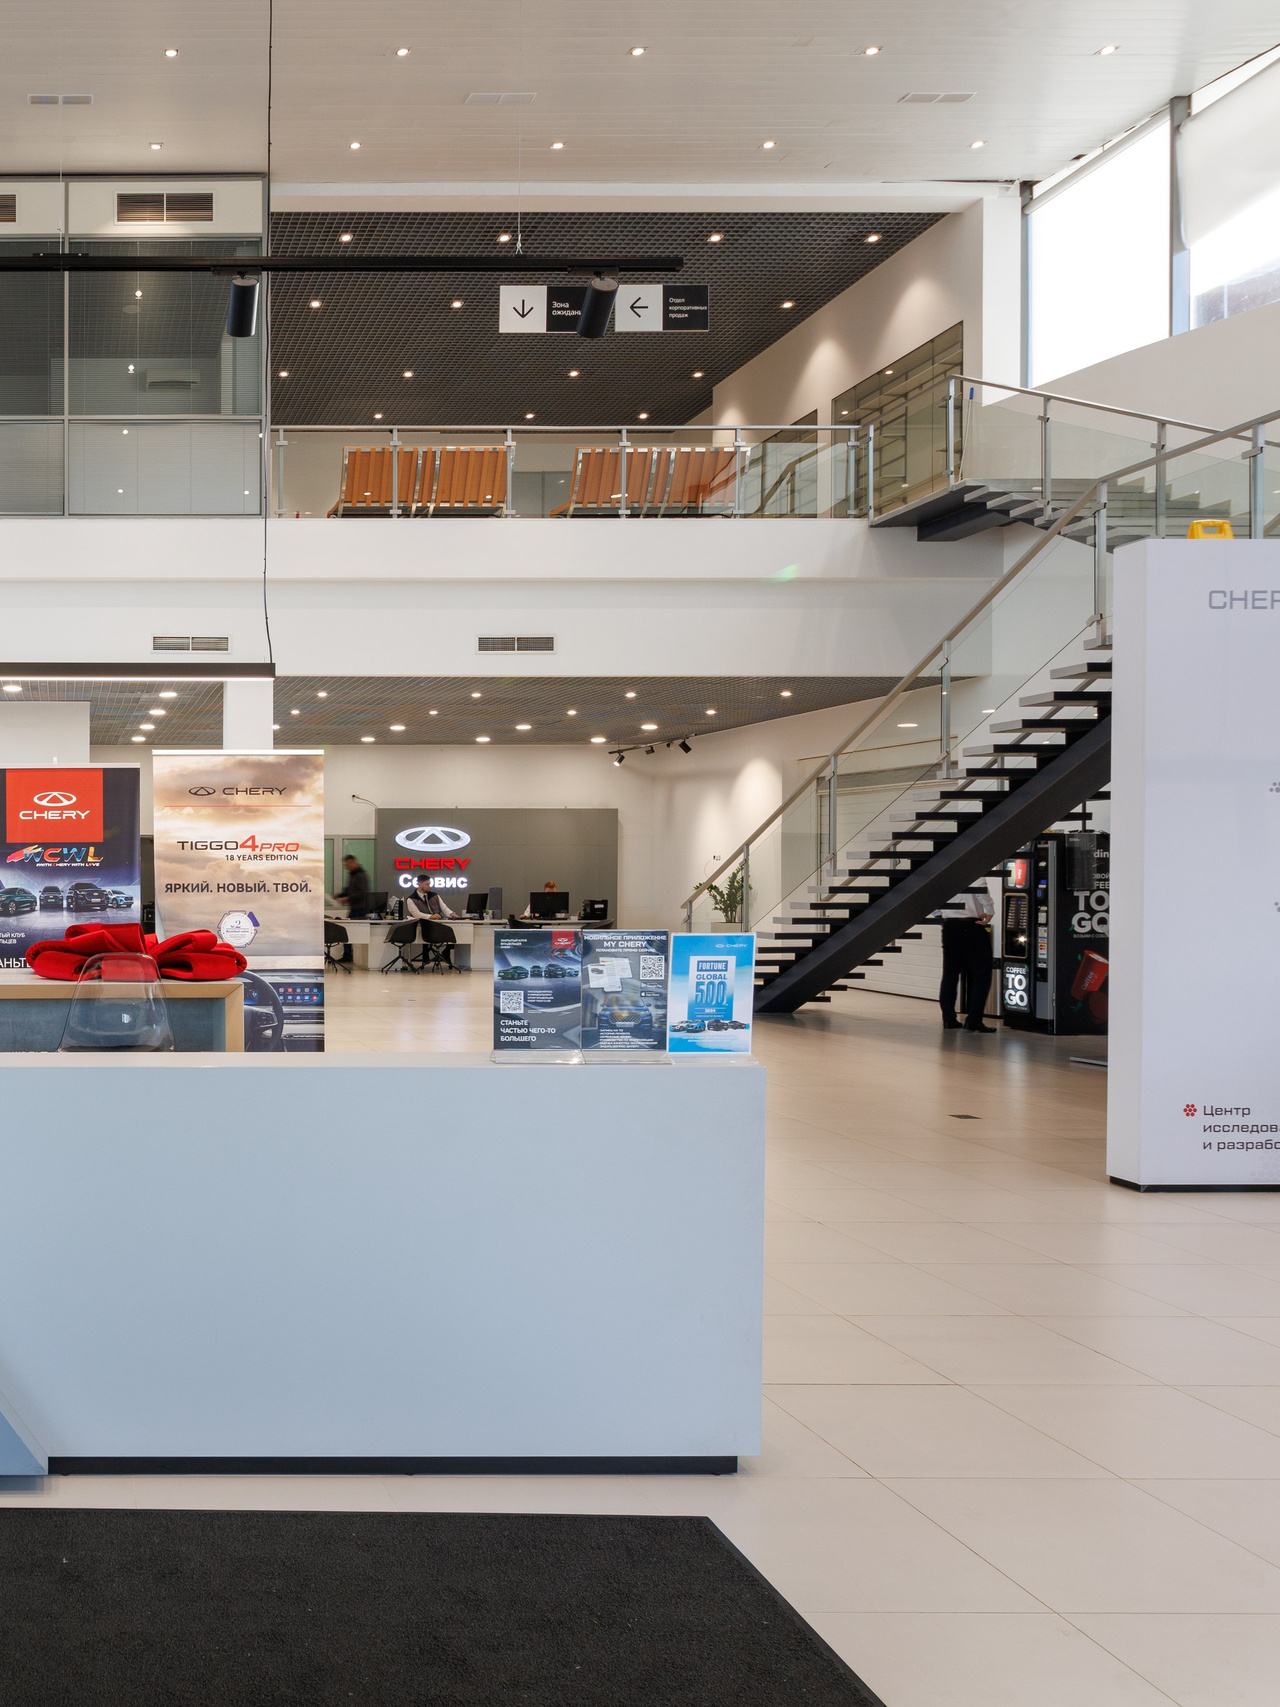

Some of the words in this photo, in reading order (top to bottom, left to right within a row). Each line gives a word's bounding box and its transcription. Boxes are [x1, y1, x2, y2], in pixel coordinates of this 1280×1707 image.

[223, 787, 287, 795] CHERY
[19, 810, 90, 820] CHERY
[395, 858, 471, 870] CHERY
[165, 881, 213, 893] ЯРКИЙ.
[217, 881, 270, 893] НОВЫЙ.
[273, 881, 312, 893] ТВОЙ.
[1073, 890, 1109, 911] TO
[1072, 912, 1109, 933] GO
[699, 962, 726, 970] FORTUNE
[1005, 974, 1026, 990] TO
[695, 981, 727, 1005] 500
[1005, 990, 1028, 1006] GO
[1203, 1105, 1251, 1117] Центр
[1203, 1124, 1280, 1134] исследов
